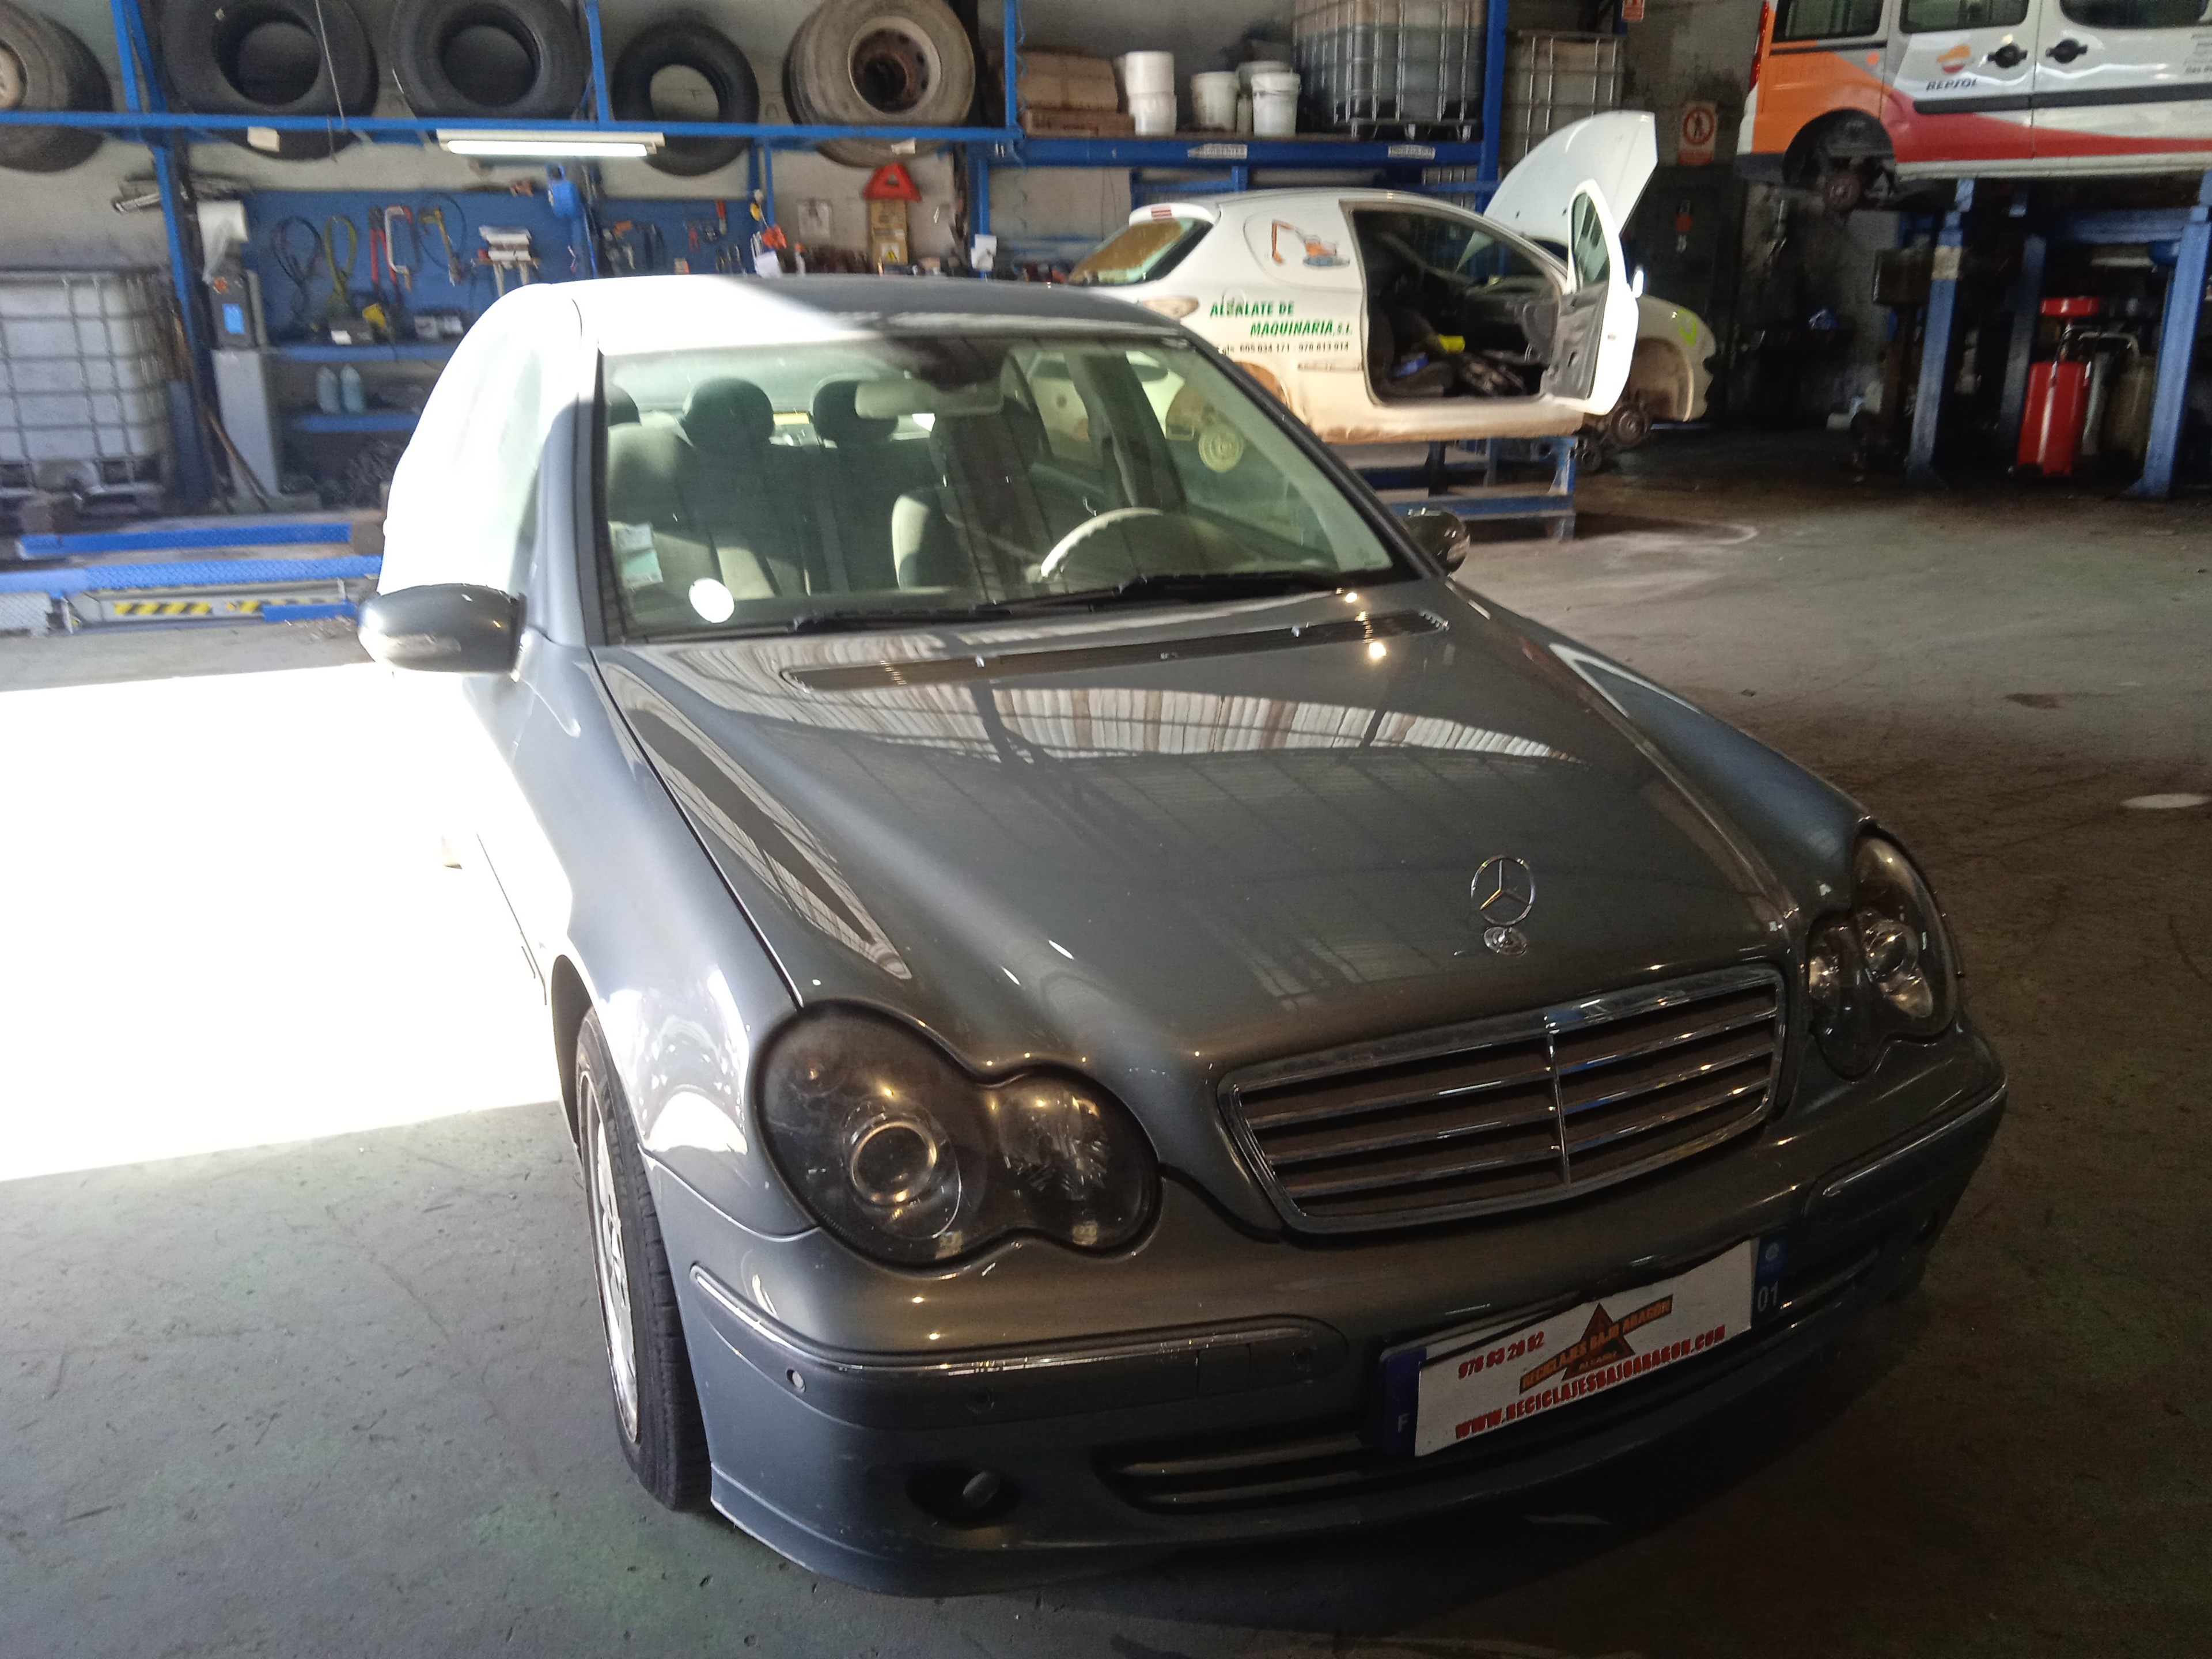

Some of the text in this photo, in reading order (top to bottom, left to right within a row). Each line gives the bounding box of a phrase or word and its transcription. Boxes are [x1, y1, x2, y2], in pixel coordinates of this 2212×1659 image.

[1278, 300, 1295, 317] DE
[1758, 1281, 1778, 1312] 01
[1589, 1323, 1618, 1351] BAJO
[1397, 1413, 1410, 1433] F
